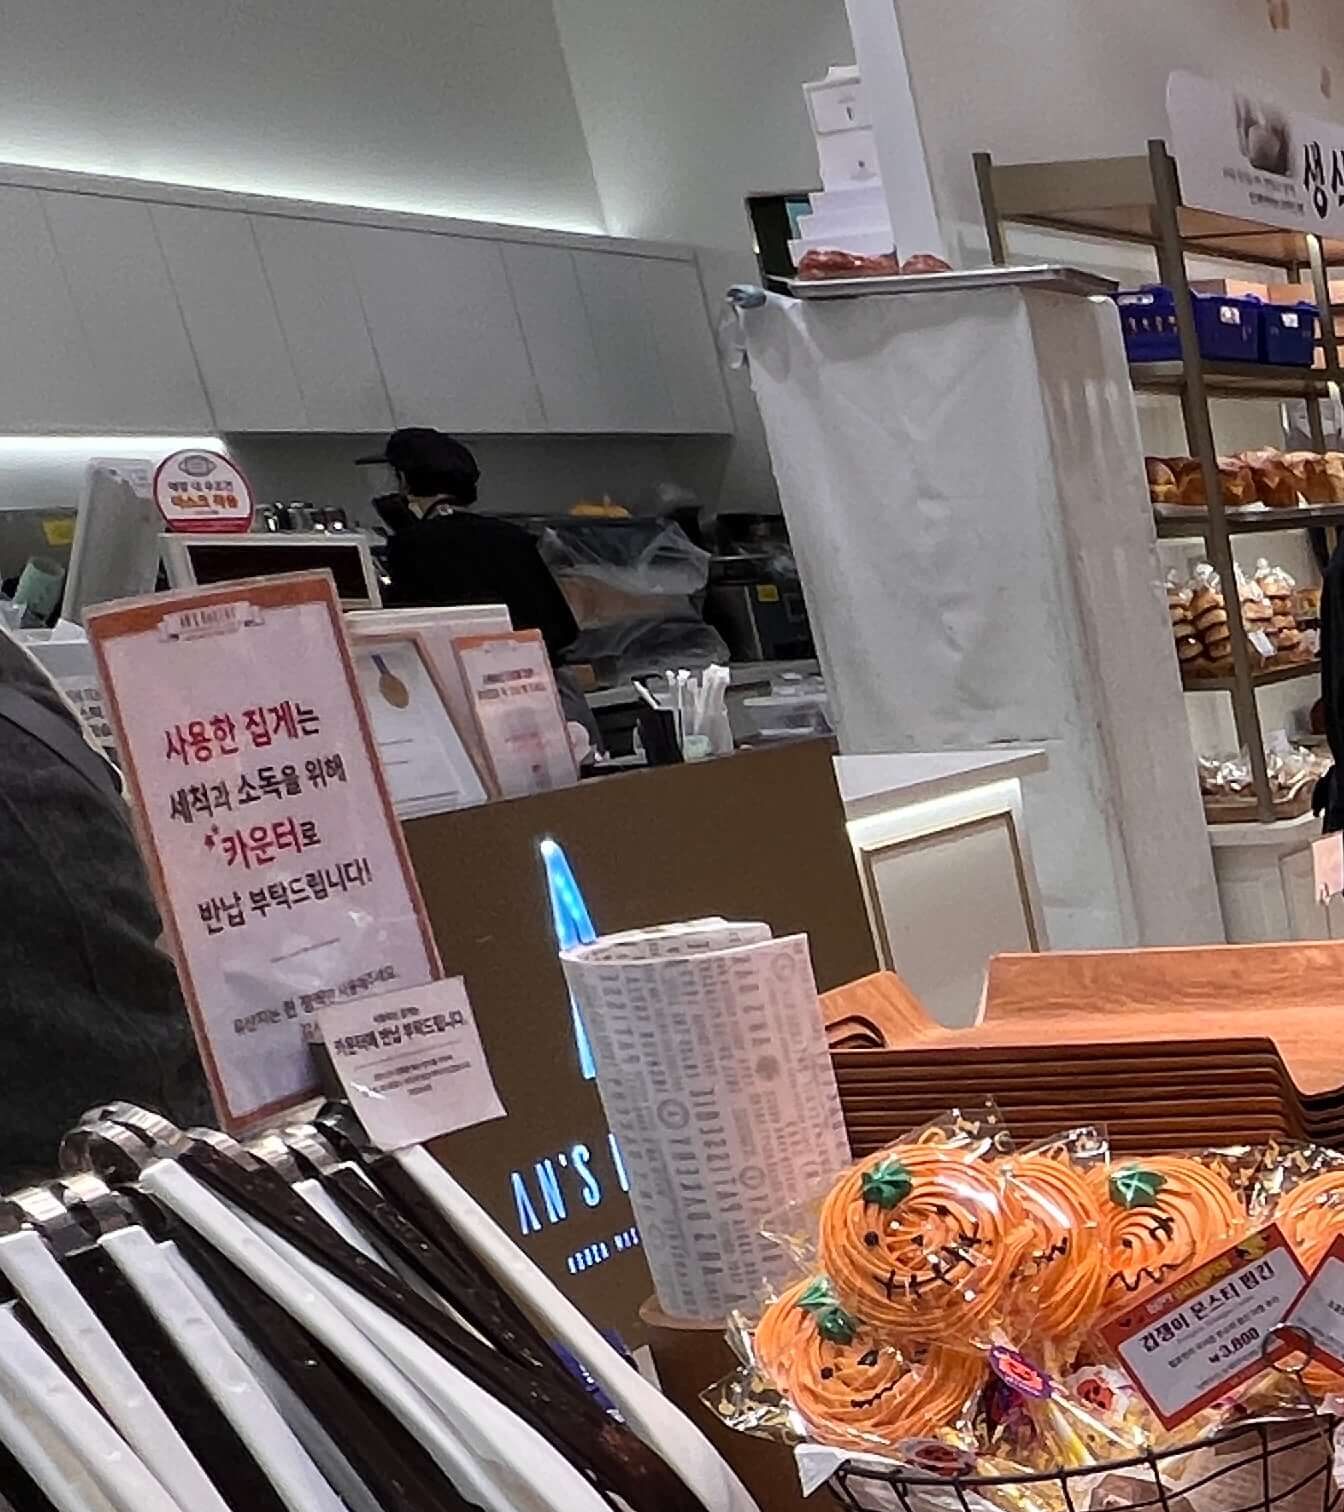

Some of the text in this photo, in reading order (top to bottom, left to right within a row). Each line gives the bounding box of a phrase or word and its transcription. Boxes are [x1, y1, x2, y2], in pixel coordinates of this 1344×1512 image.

[164, 712, 240, 766] 사용한
[241, 700, 320, 749] 집게는
[169, 753, 348, 825] 세척과 소독을 위해
[197, 857, 374, 937] 반납 부탁드립니다!
